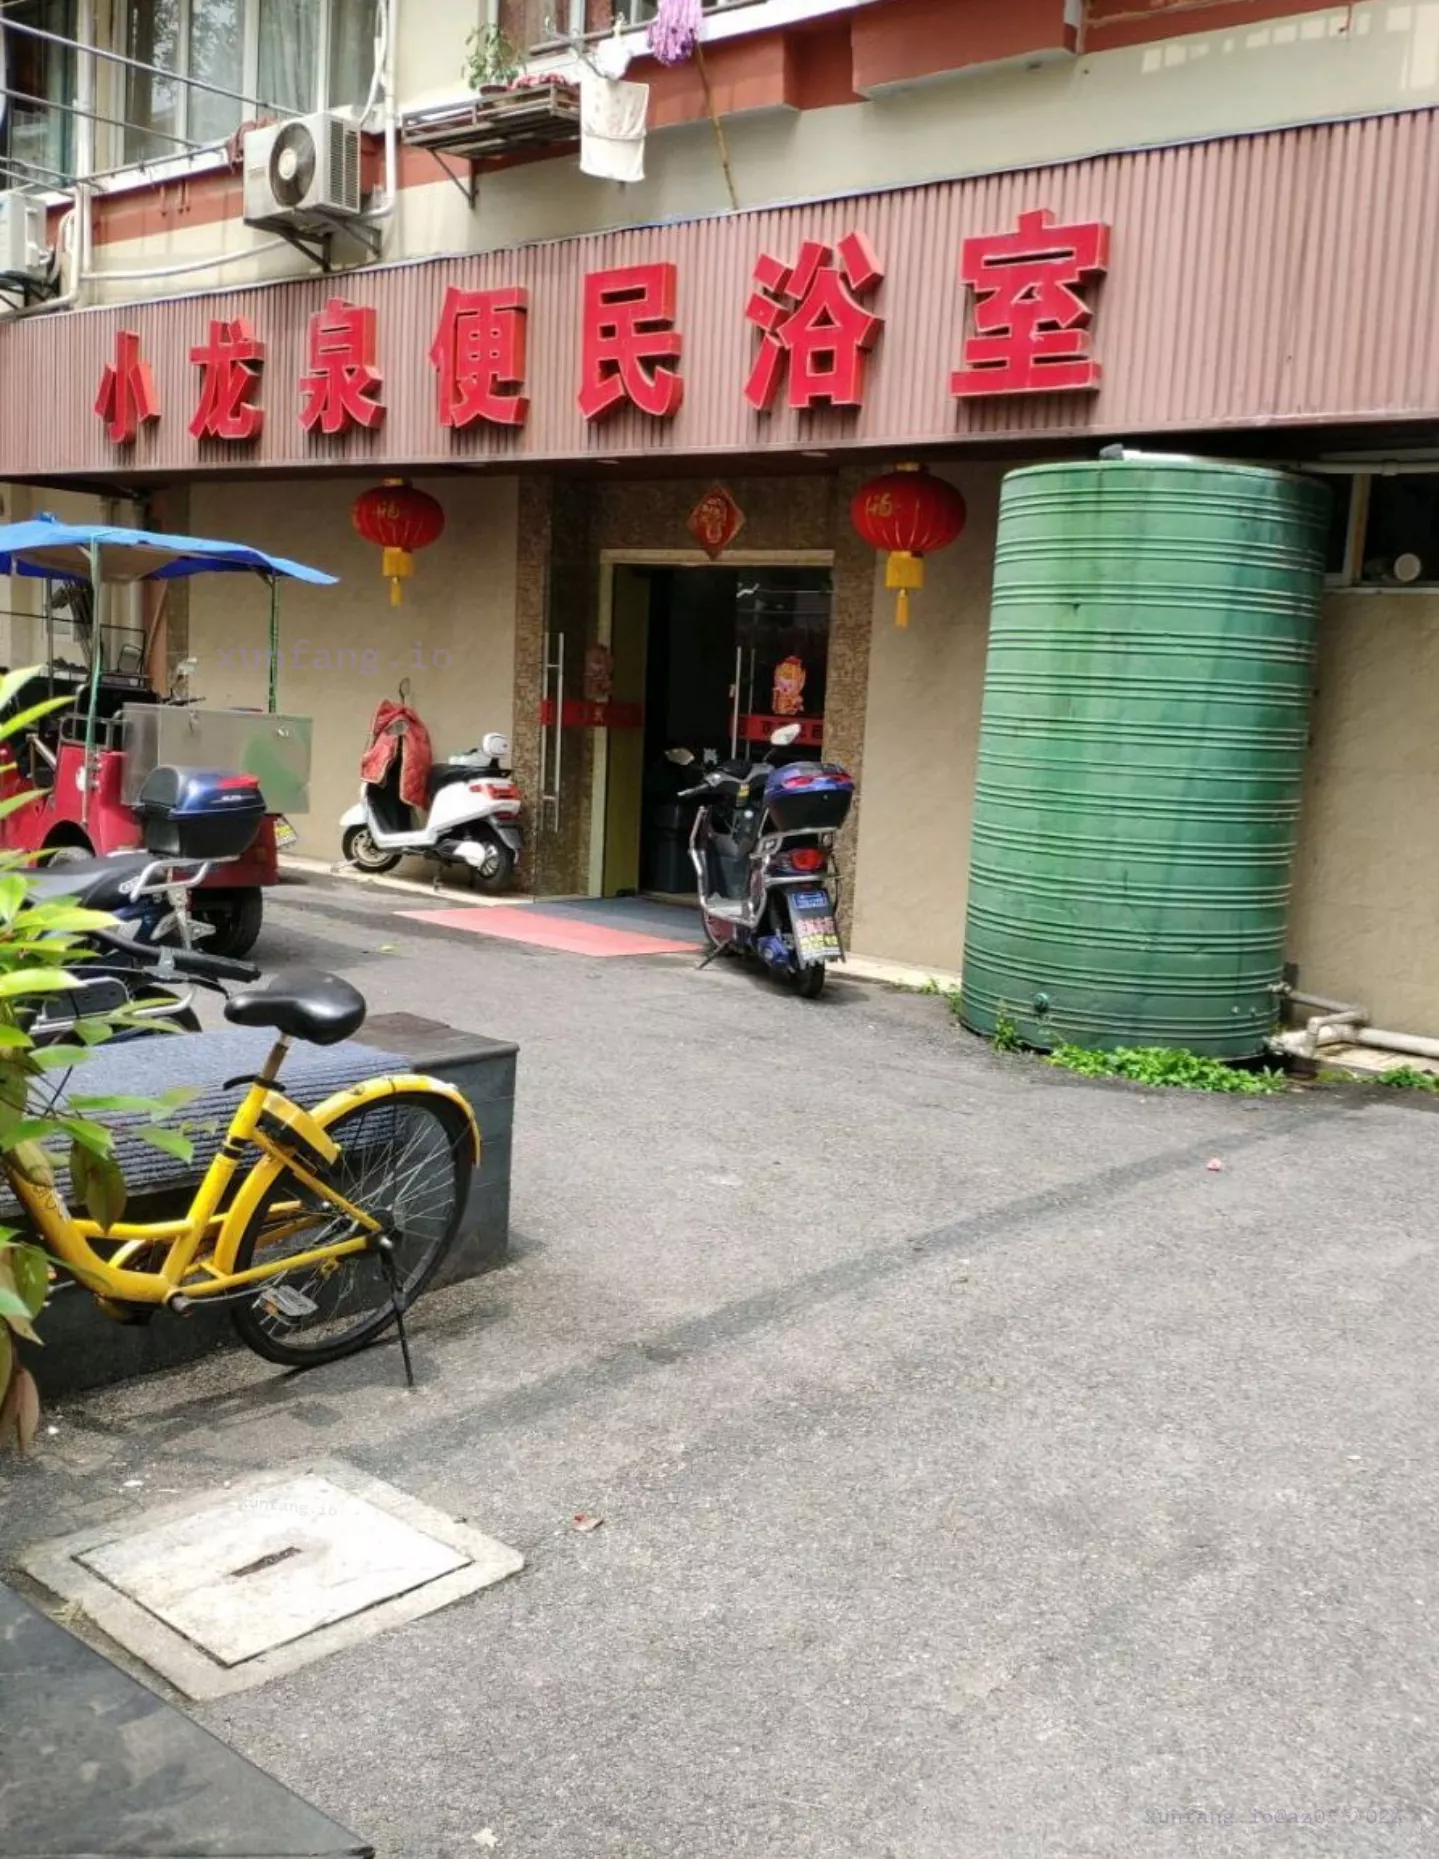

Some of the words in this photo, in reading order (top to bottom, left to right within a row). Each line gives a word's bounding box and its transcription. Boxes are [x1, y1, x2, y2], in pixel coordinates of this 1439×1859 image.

[94, 209, 1110, 444] 小龙泉便民浴室
